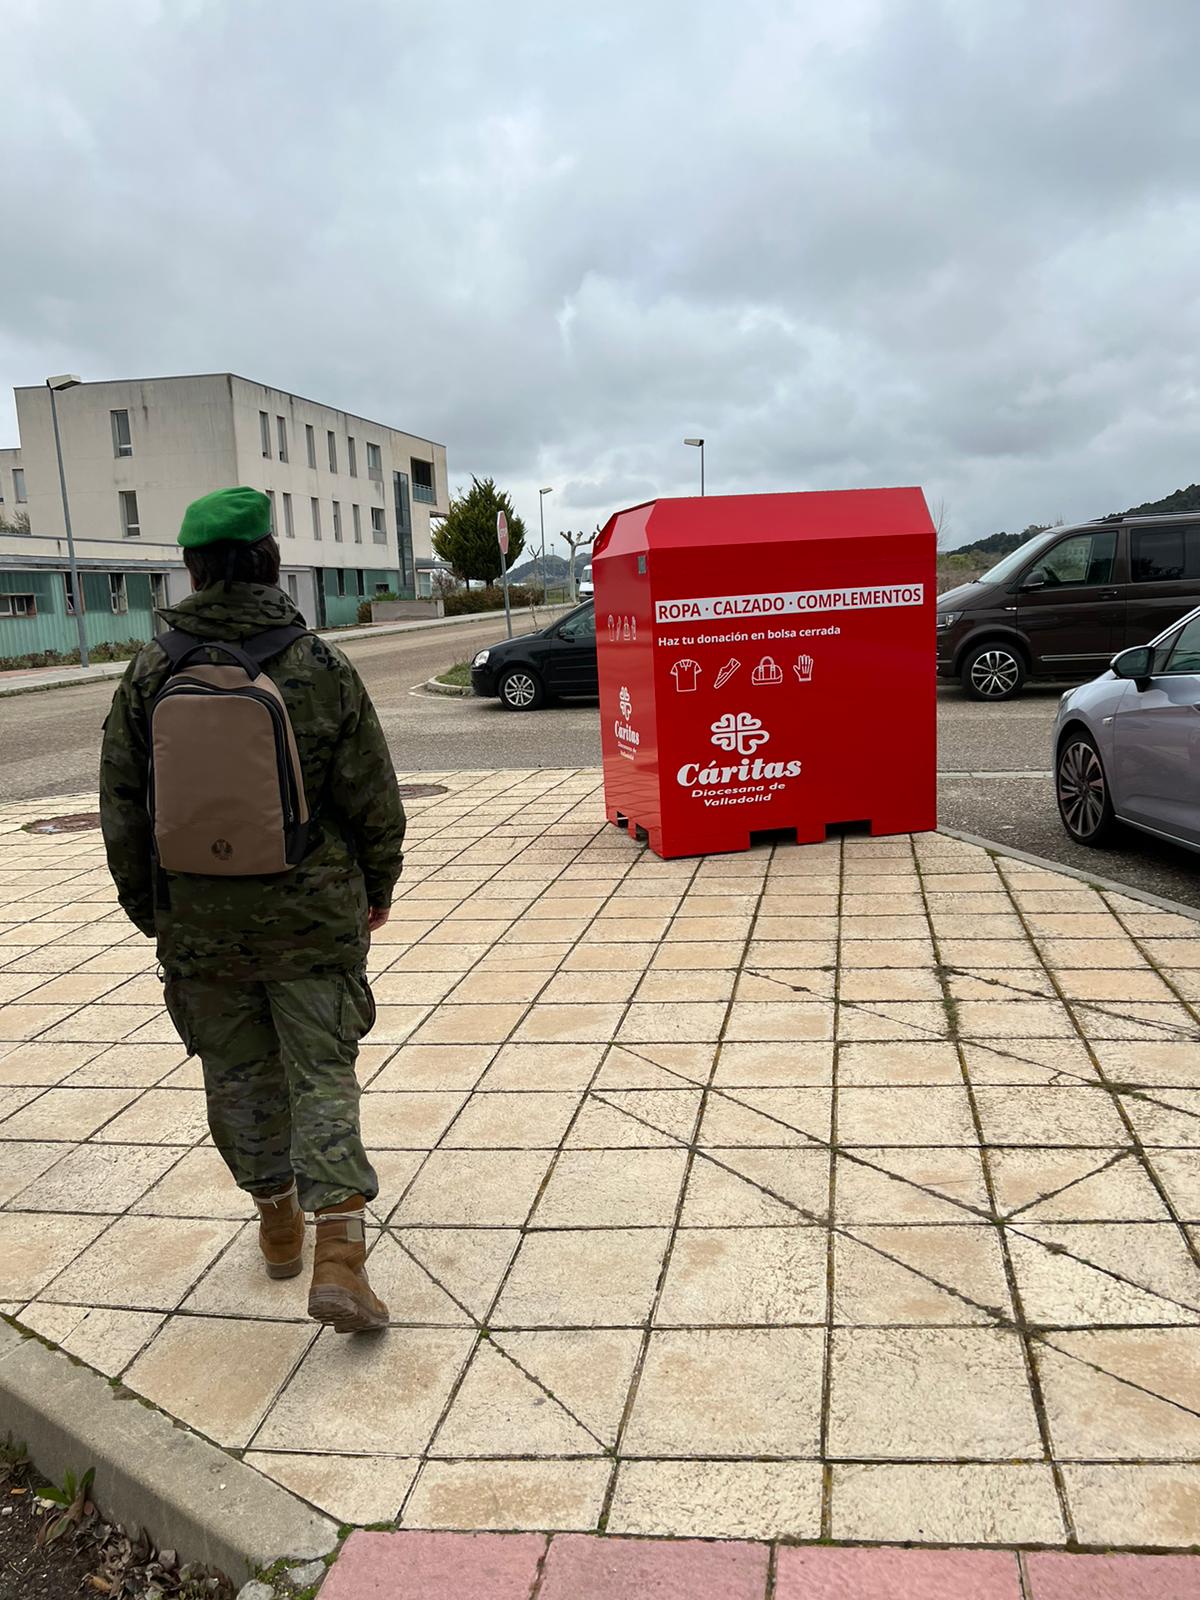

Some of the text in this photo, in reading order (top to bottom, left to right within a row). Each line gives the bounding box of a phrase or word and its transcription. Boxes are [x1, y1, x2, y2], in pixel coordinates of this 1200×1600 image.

[658, 587, 921, 620] ROPA CALZADO COMPLEMENTOS
[658, 625, 841, 647] Haz tu donación en bolsa cerrada
[676, 758, 802, 787] Cáritas
[691, 782, 786, 798] Diocesana de
[703, 793, 772, 807] Valladolid
